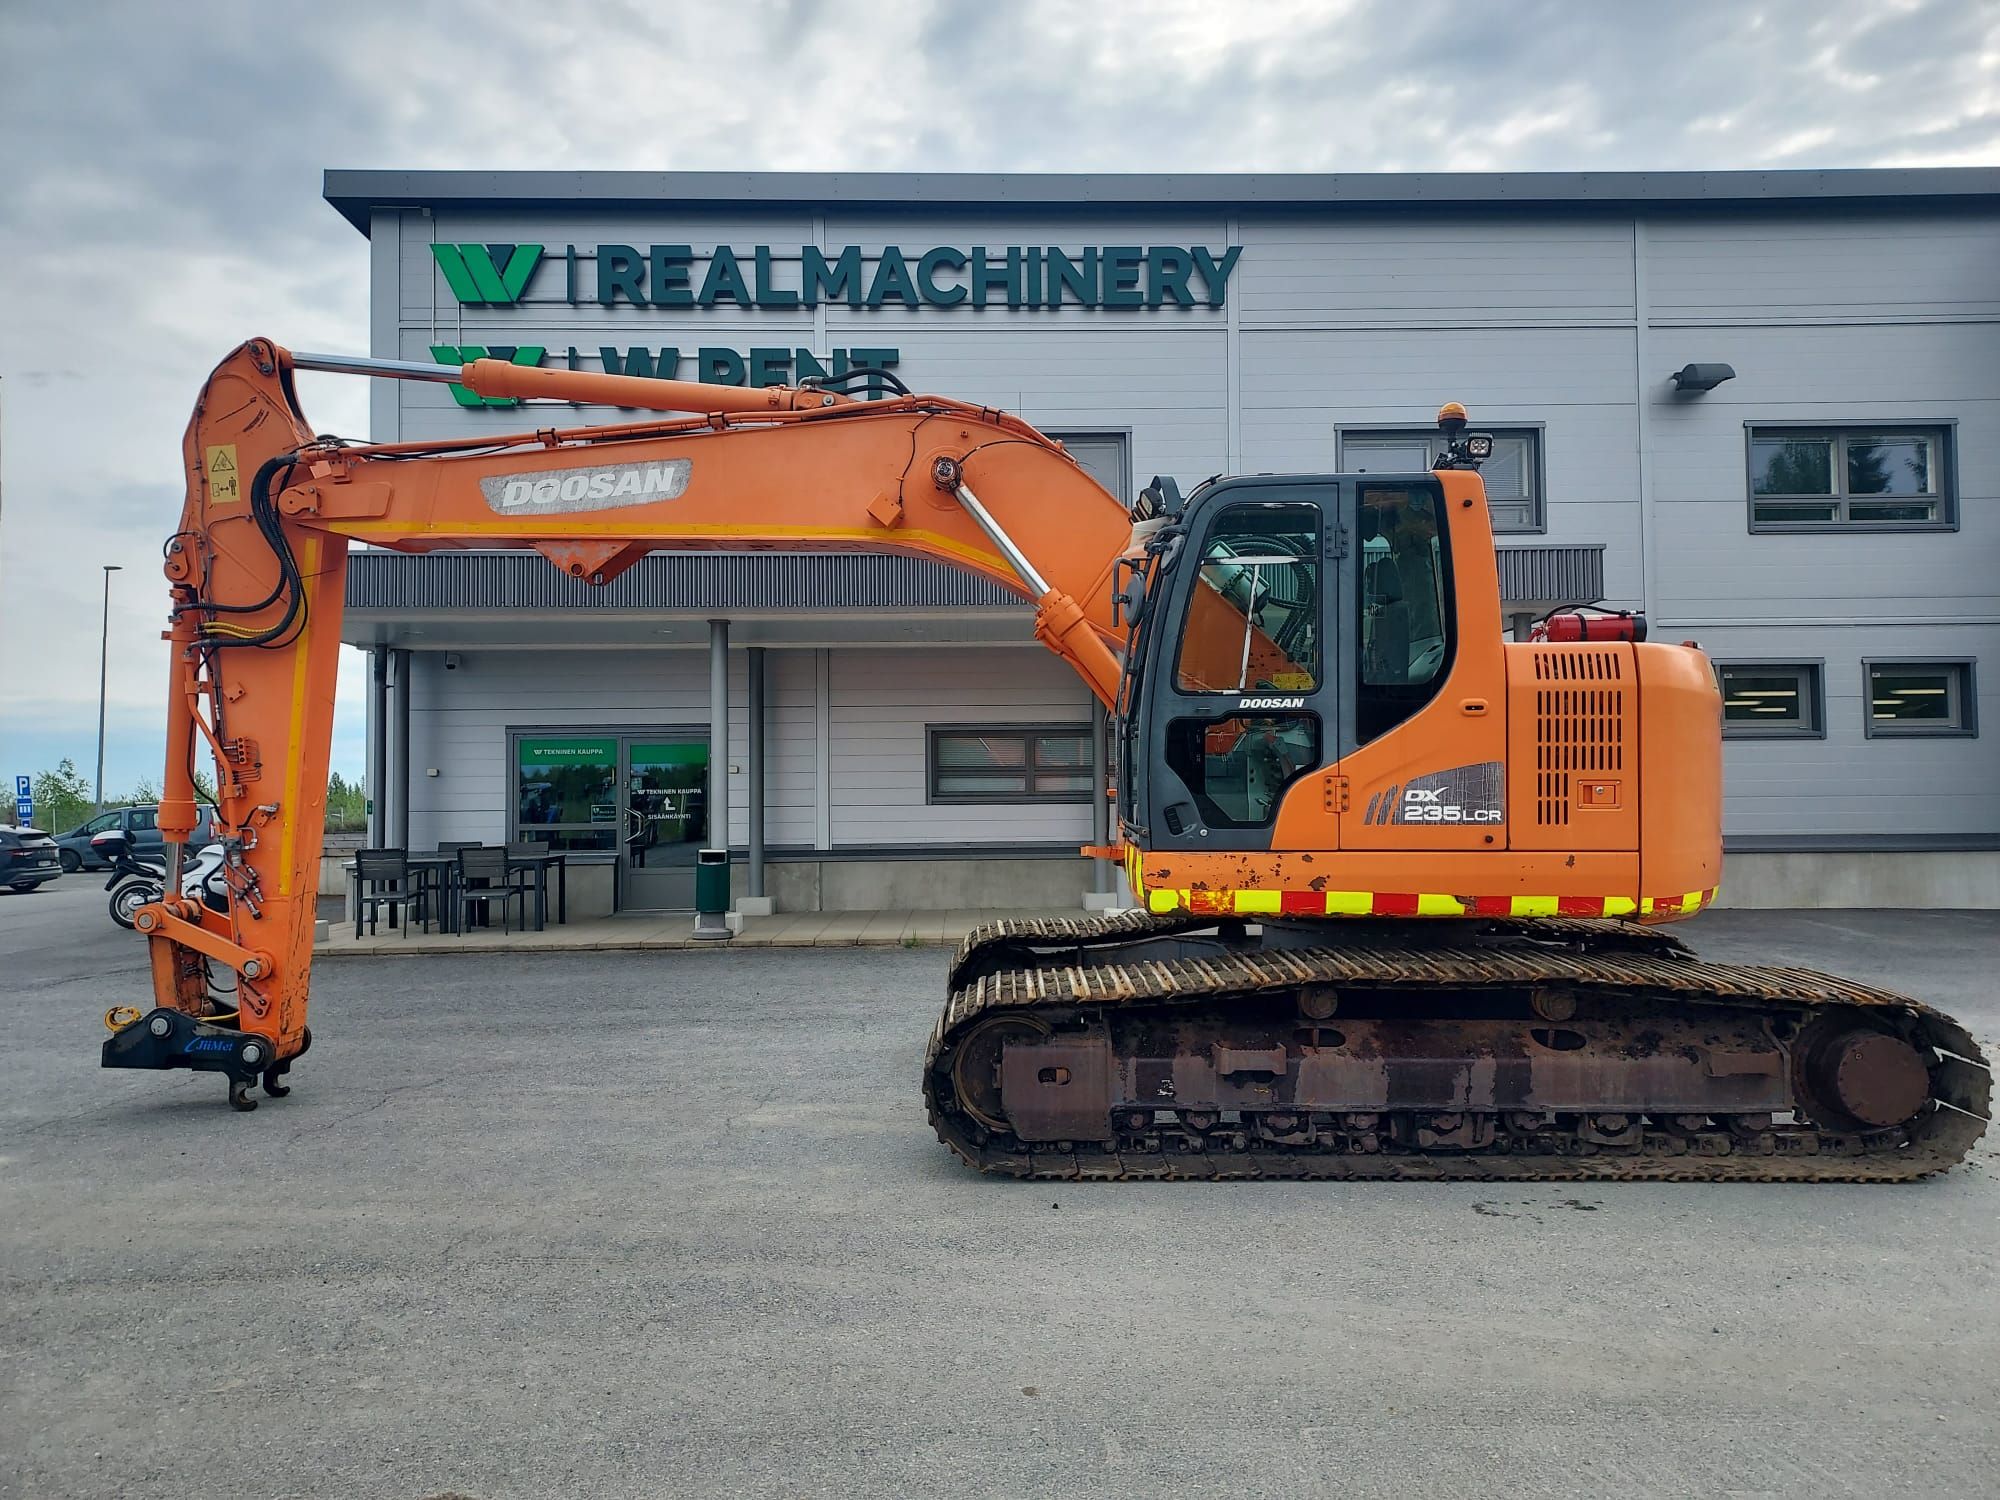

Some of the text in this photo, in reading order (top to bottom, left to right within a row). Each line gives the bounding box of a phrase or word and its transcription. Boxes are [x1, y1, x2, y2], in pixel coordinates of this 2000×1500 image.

[597, 244, 1244, 306] REALMACHINERY
[502, 467, 675, 507] DOOSAN
[1239, 698, 1305, 709] DOOSAN
[19, 778, 28, 794] P
[1405, 787, 1449, 802] DX
